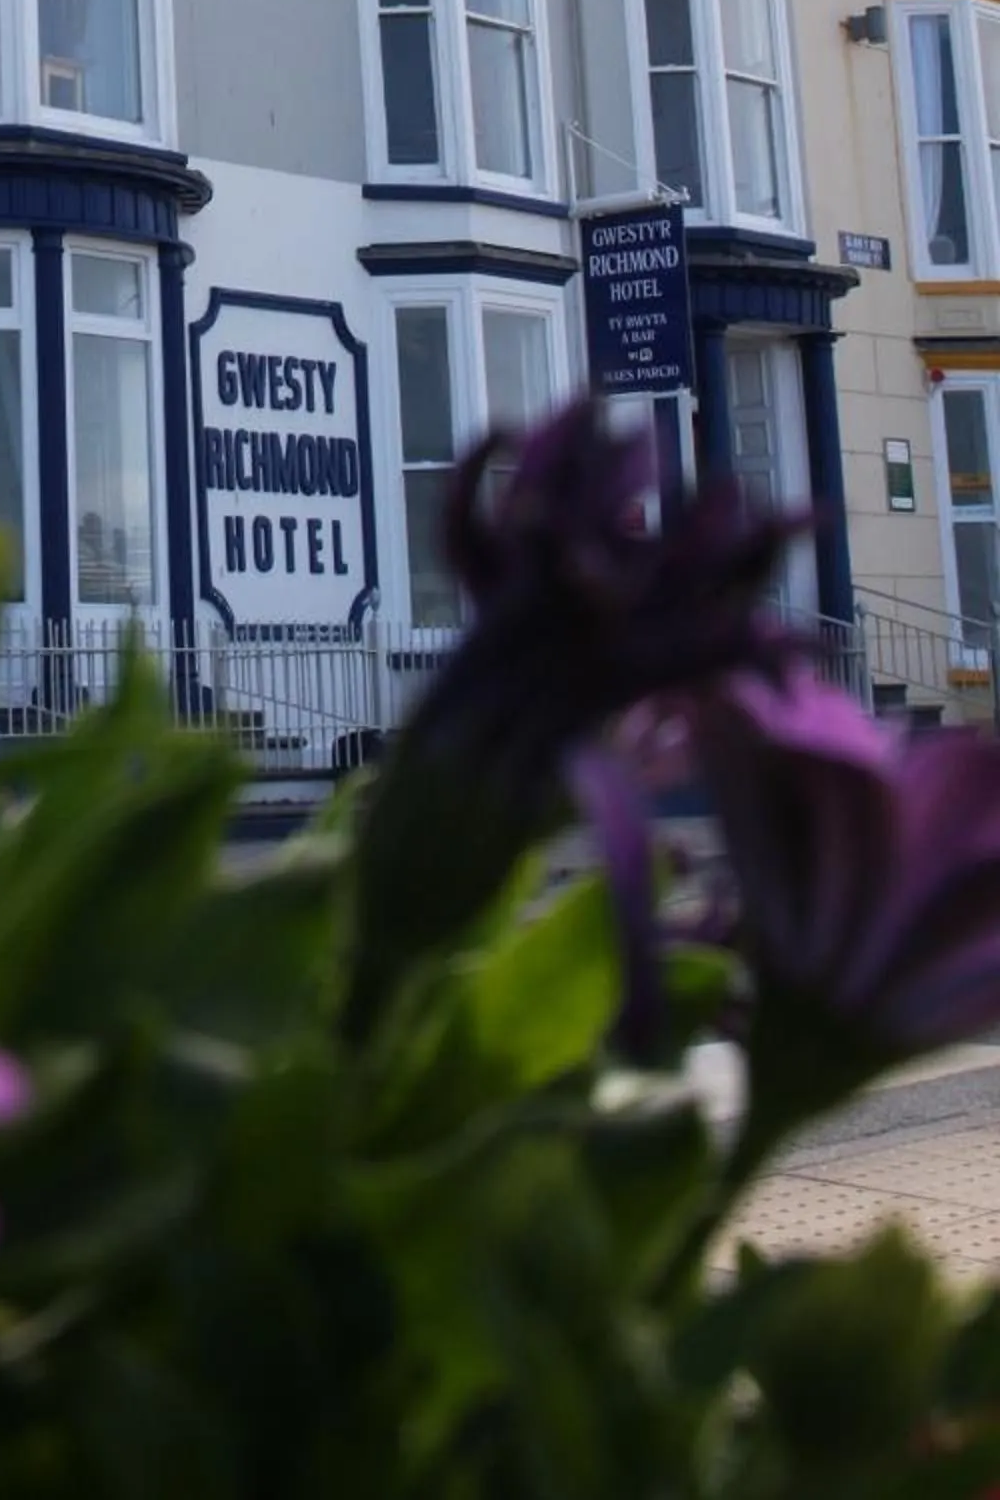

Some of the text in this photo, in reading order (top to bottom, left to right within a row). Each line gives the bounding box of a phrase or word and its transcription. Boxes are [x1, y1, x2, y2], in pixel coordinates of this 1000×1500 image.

[591, 219, 672, 248] GWESTY'R
[588, 245, 679, 278] RICHMOND
[609, 278, 663, 303] HOTEL
[216, 350, 337, 415] GWESTY
[637, 364, 680, 381] PARCIO
[203, 426, 359, 498] RICHMOND
[223, 514, 349, 577] HOTEL
